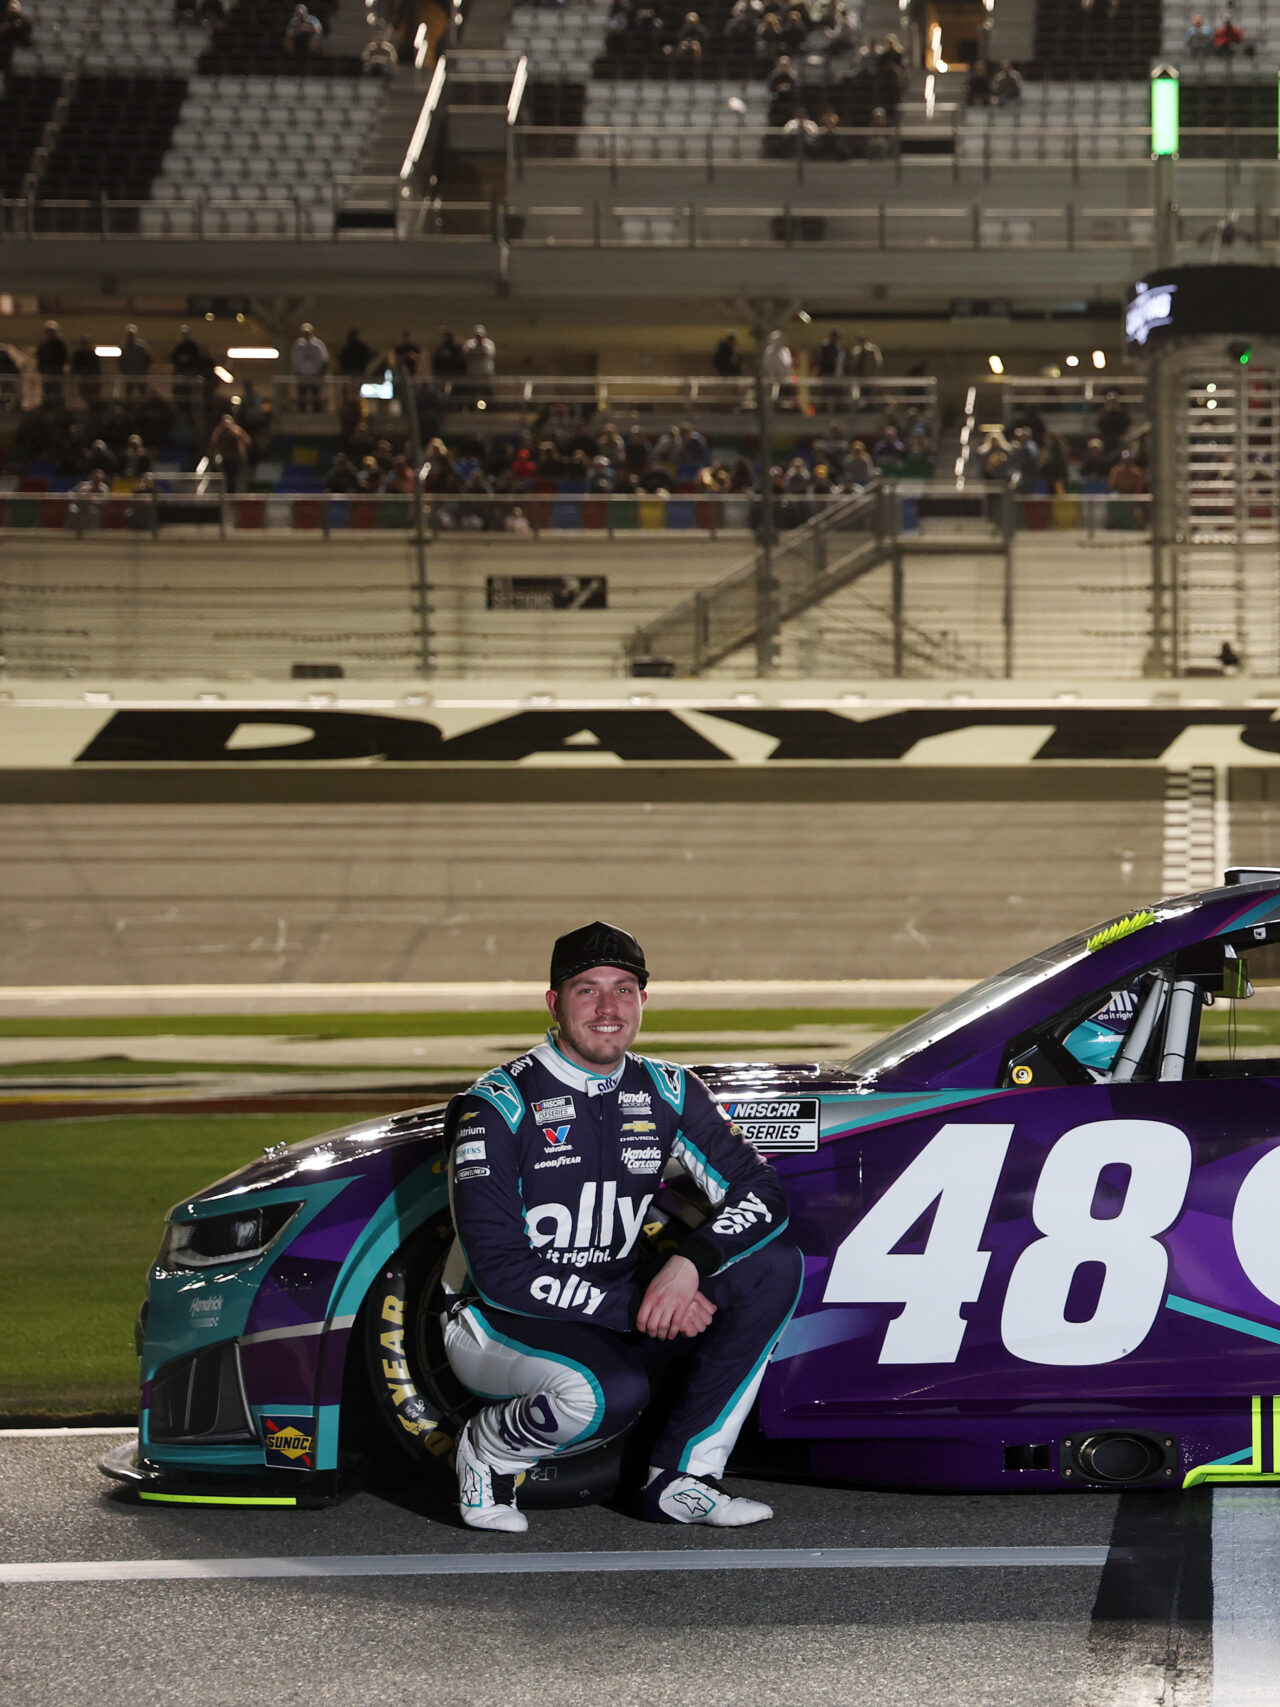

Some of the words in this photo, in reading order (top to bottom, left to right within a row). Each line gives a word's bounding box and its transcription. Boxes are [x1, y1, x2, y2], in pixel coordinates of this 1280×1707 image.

[1097, 1013, 1109, 1021] do
[510, 1054, 535, 1077] ally
[733, 1102, 801, 1118] NASCAR
[745, 1125, 801, 1140] SERIES
[544, 1144, 573, 1154] Valvoline
[526, 1180, 654, 1259] ally
[711, 1192, 773, 1235] ally
[822, 1118, 1192, 1366] 48
[529, 1273, 608, 1316] ally
